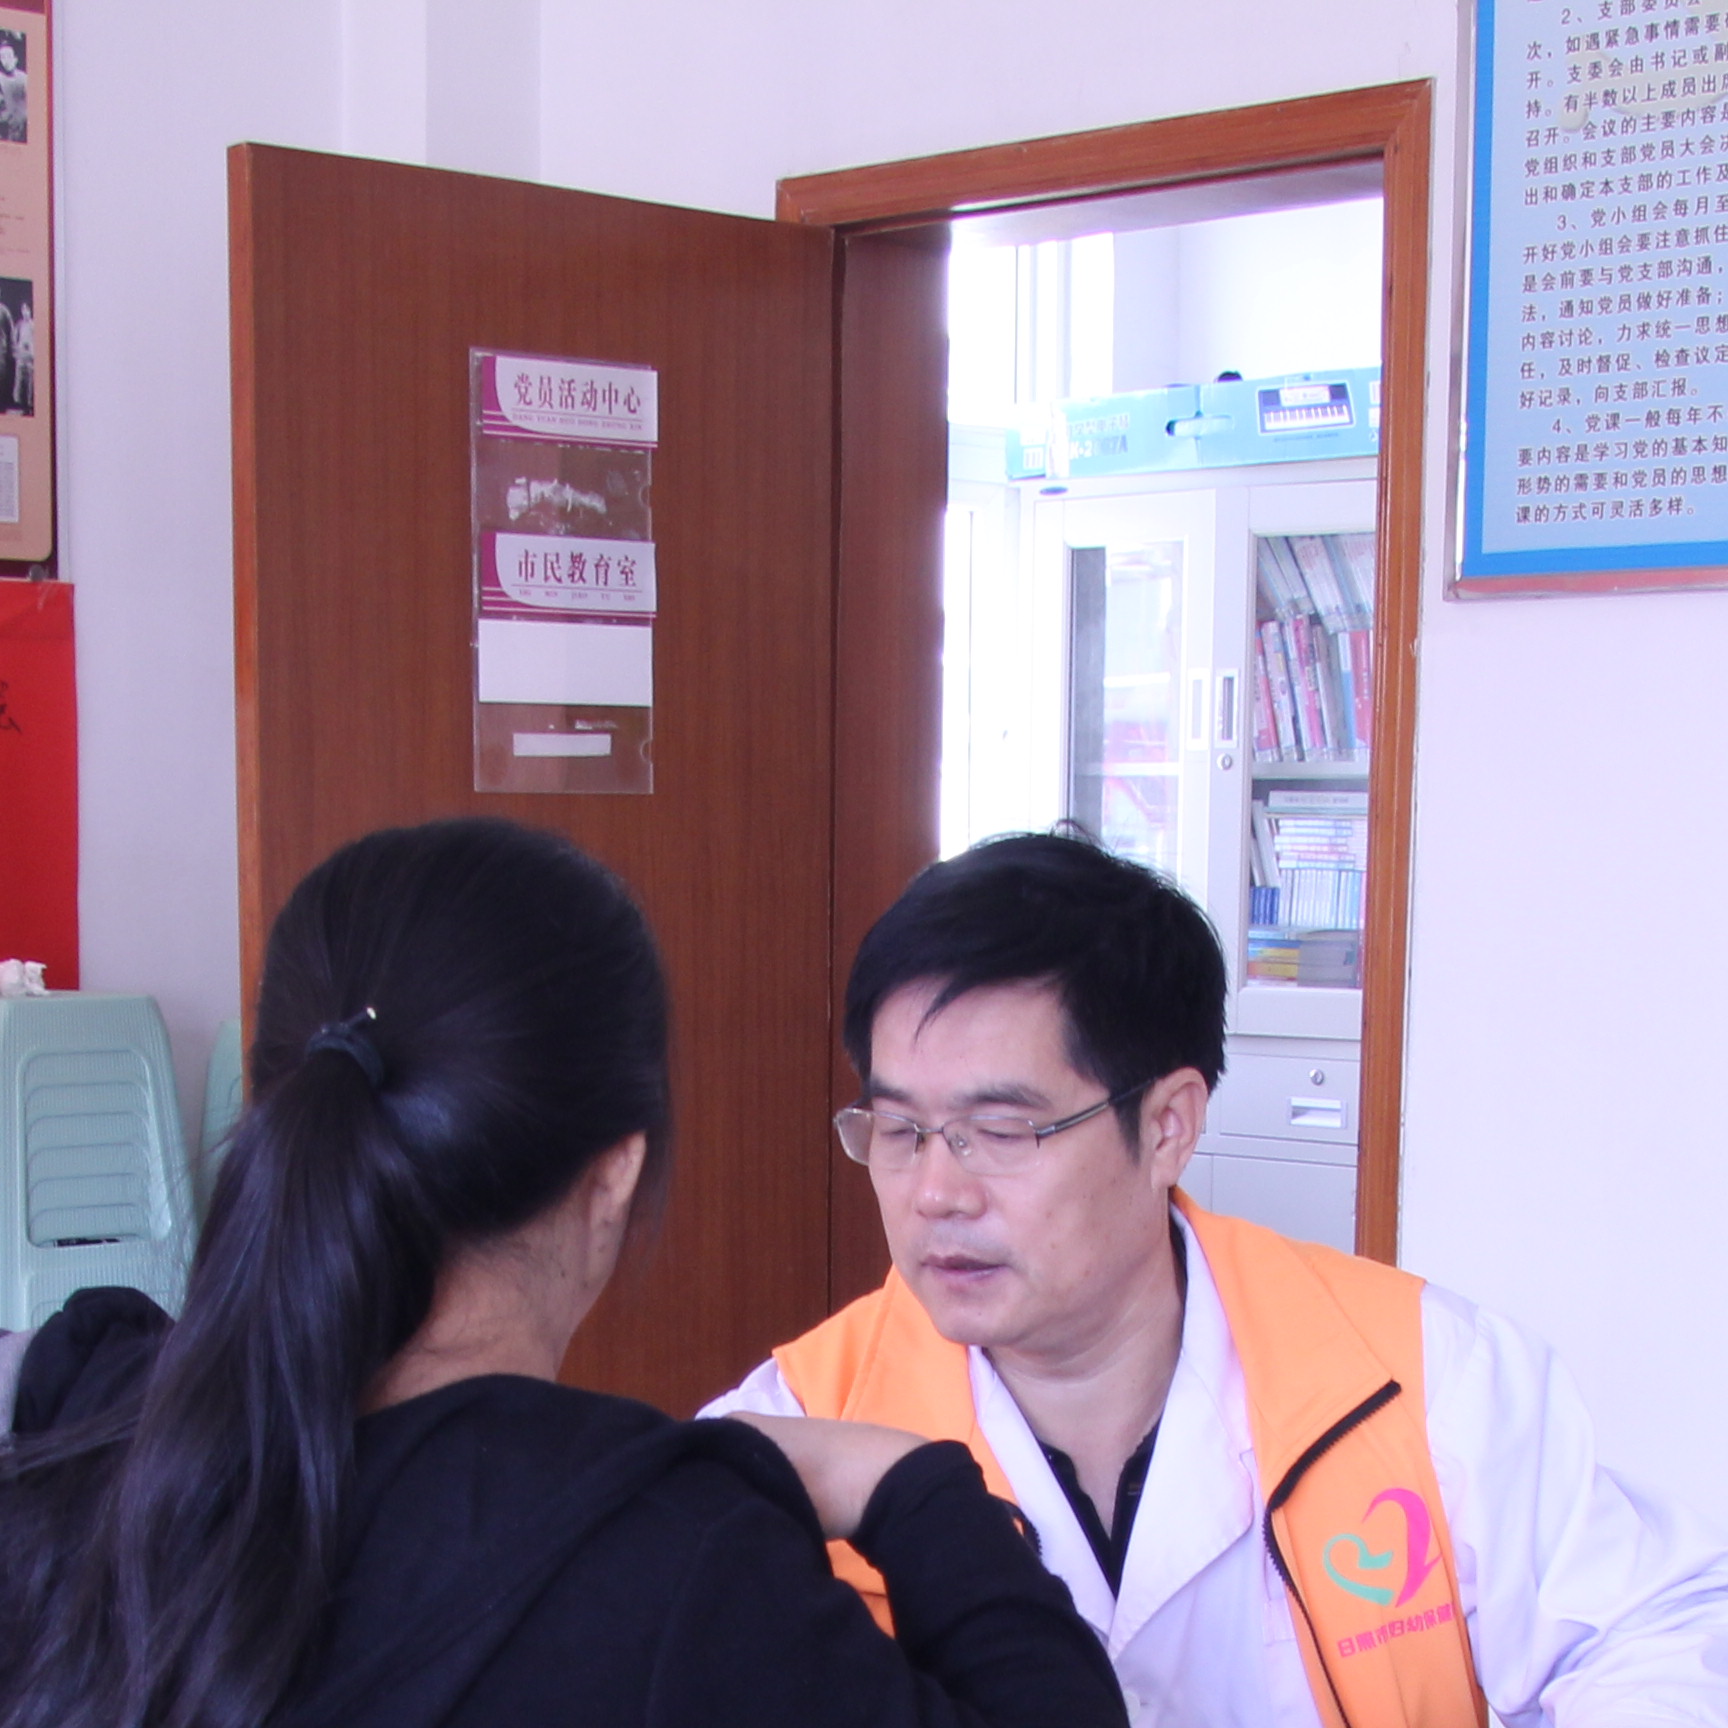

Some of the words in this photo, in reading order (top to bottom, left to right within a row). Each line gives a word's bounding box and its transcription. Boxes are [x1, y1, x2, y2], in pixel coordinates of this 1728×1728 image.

[514, 373, 641, 415] 党员活动中心
[1519, 380, 1698, 410] 好记录，向支部汇报。
[1515, 497, 1695, 525] 课的方式可灵活多样。
[517, 549, 637, 588] 市民教育室
